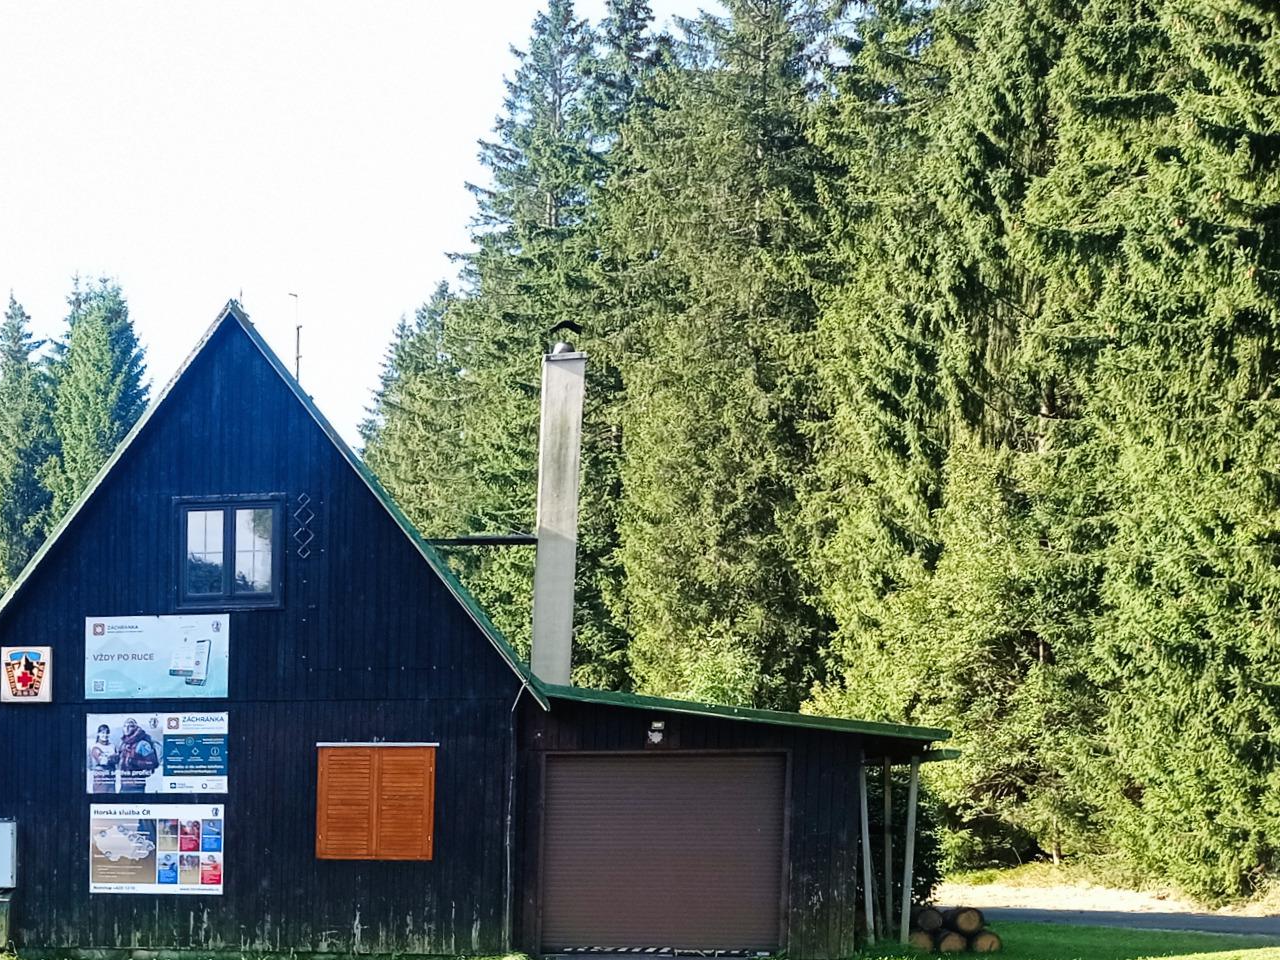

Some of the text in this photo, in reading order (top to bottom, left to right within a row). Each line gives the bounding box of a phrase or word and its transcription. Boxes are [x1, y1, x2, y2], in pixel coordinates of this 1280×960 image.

[93, 653, 154, 661] VŽDY PO RUCE
